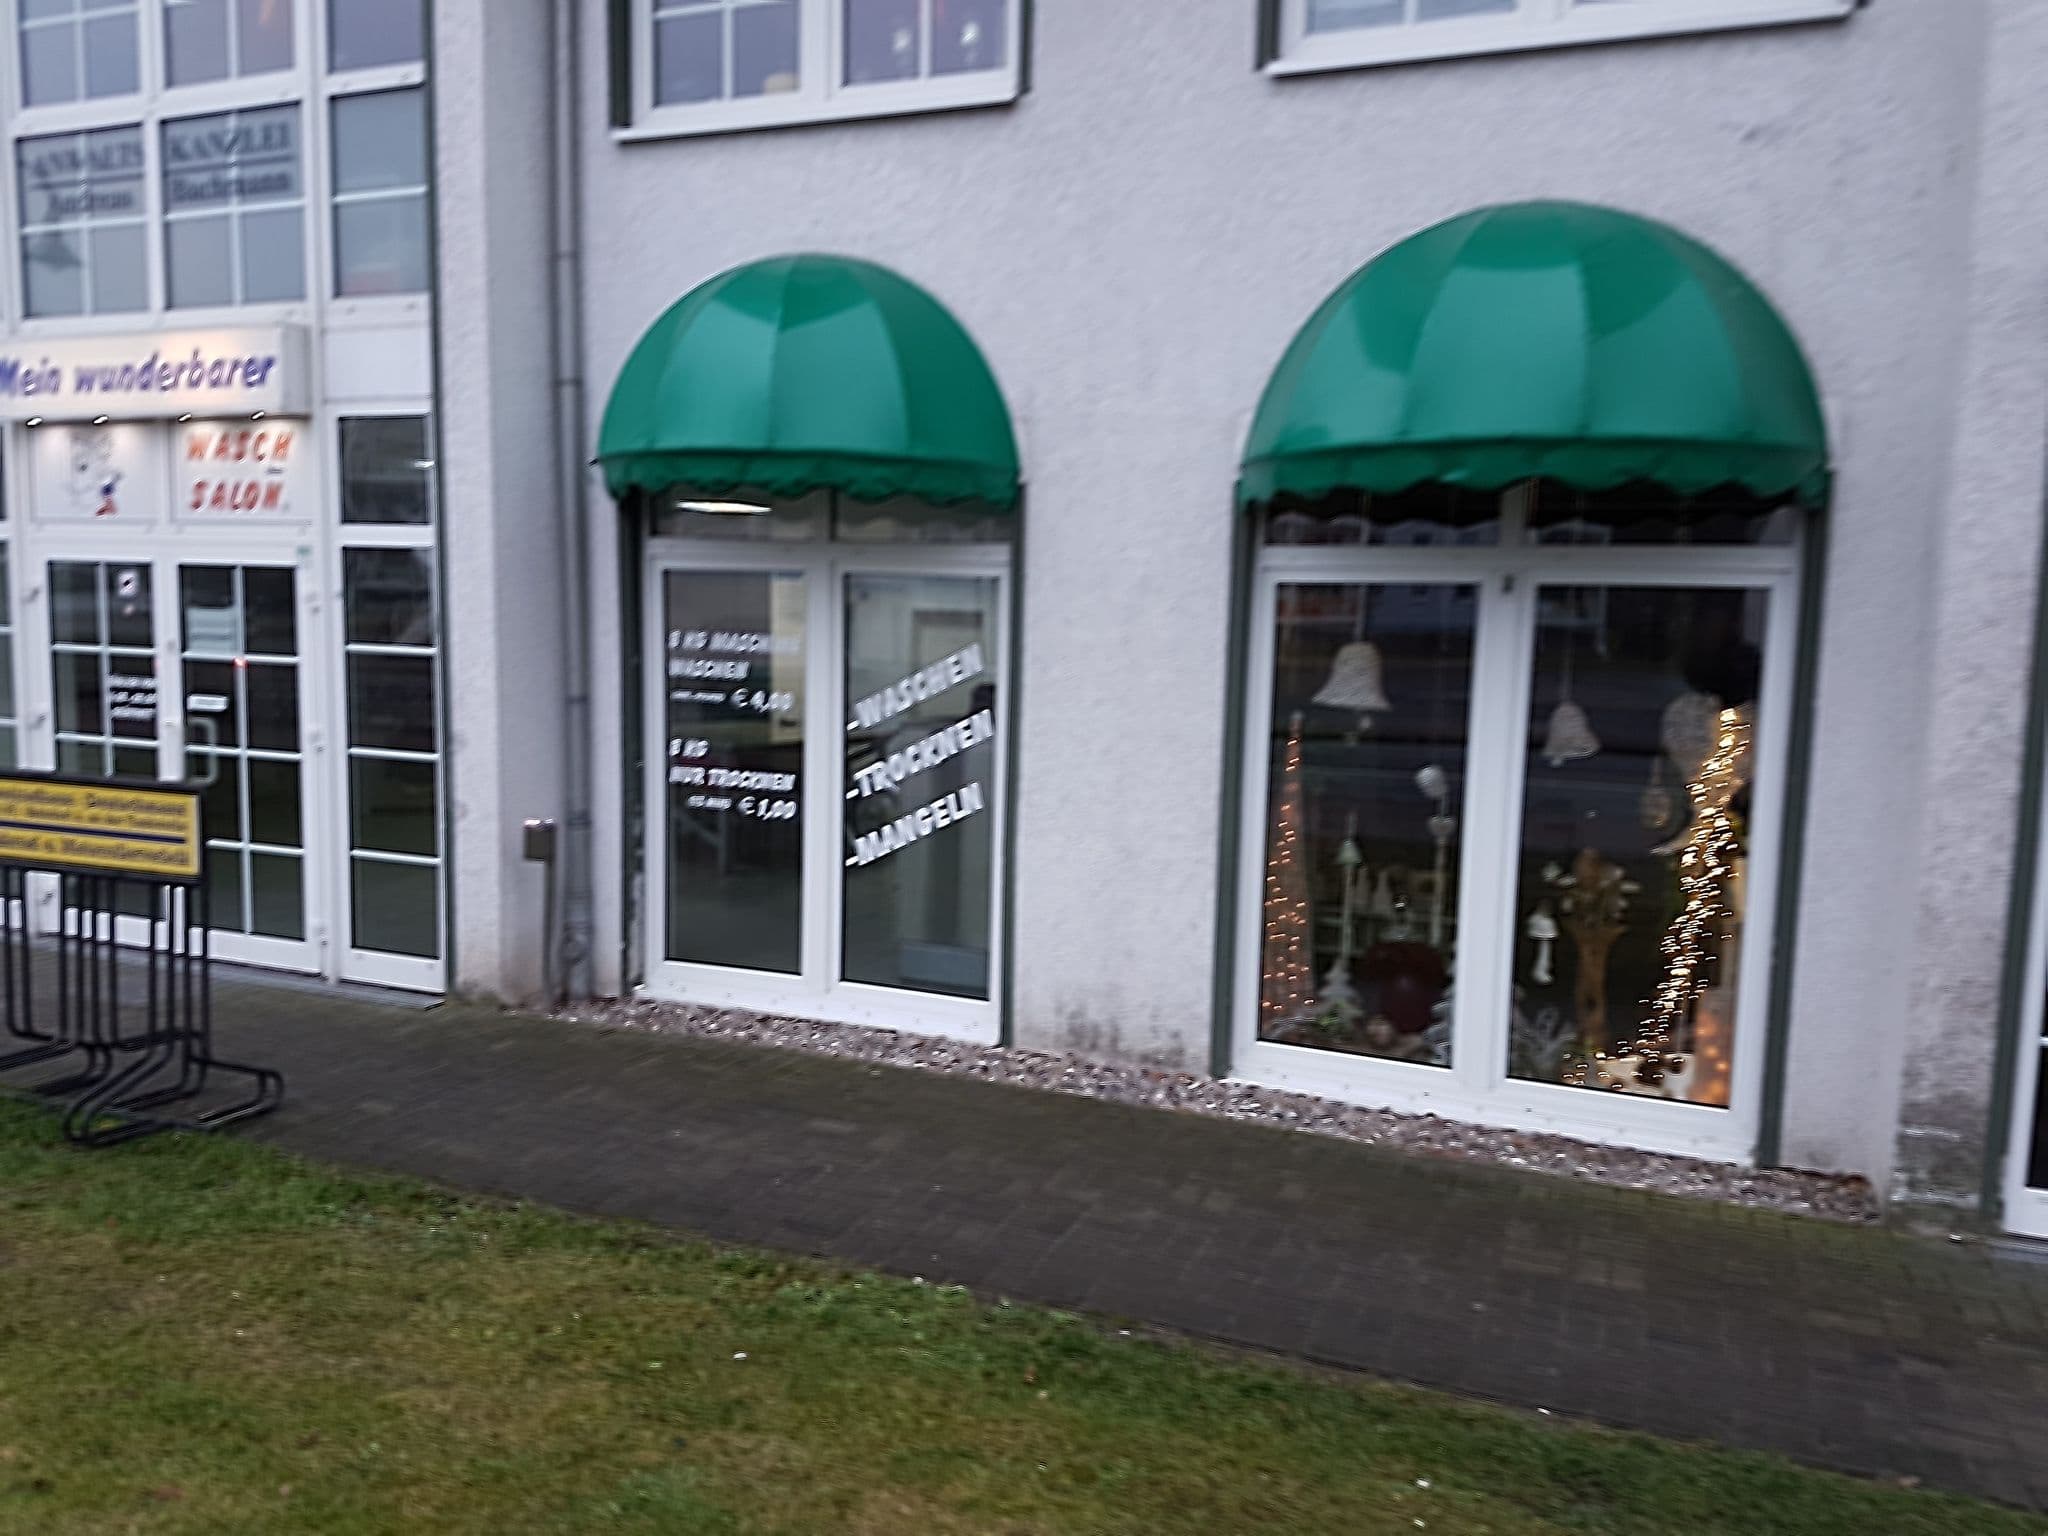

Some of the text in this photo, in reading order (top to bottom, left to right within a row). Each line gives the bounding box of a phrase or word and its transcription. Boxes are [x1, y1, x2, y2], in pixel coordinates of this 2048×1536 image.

[0, 347, 276, 395] Mein wunderbarer
[190, 479, 283, 511] SALON
